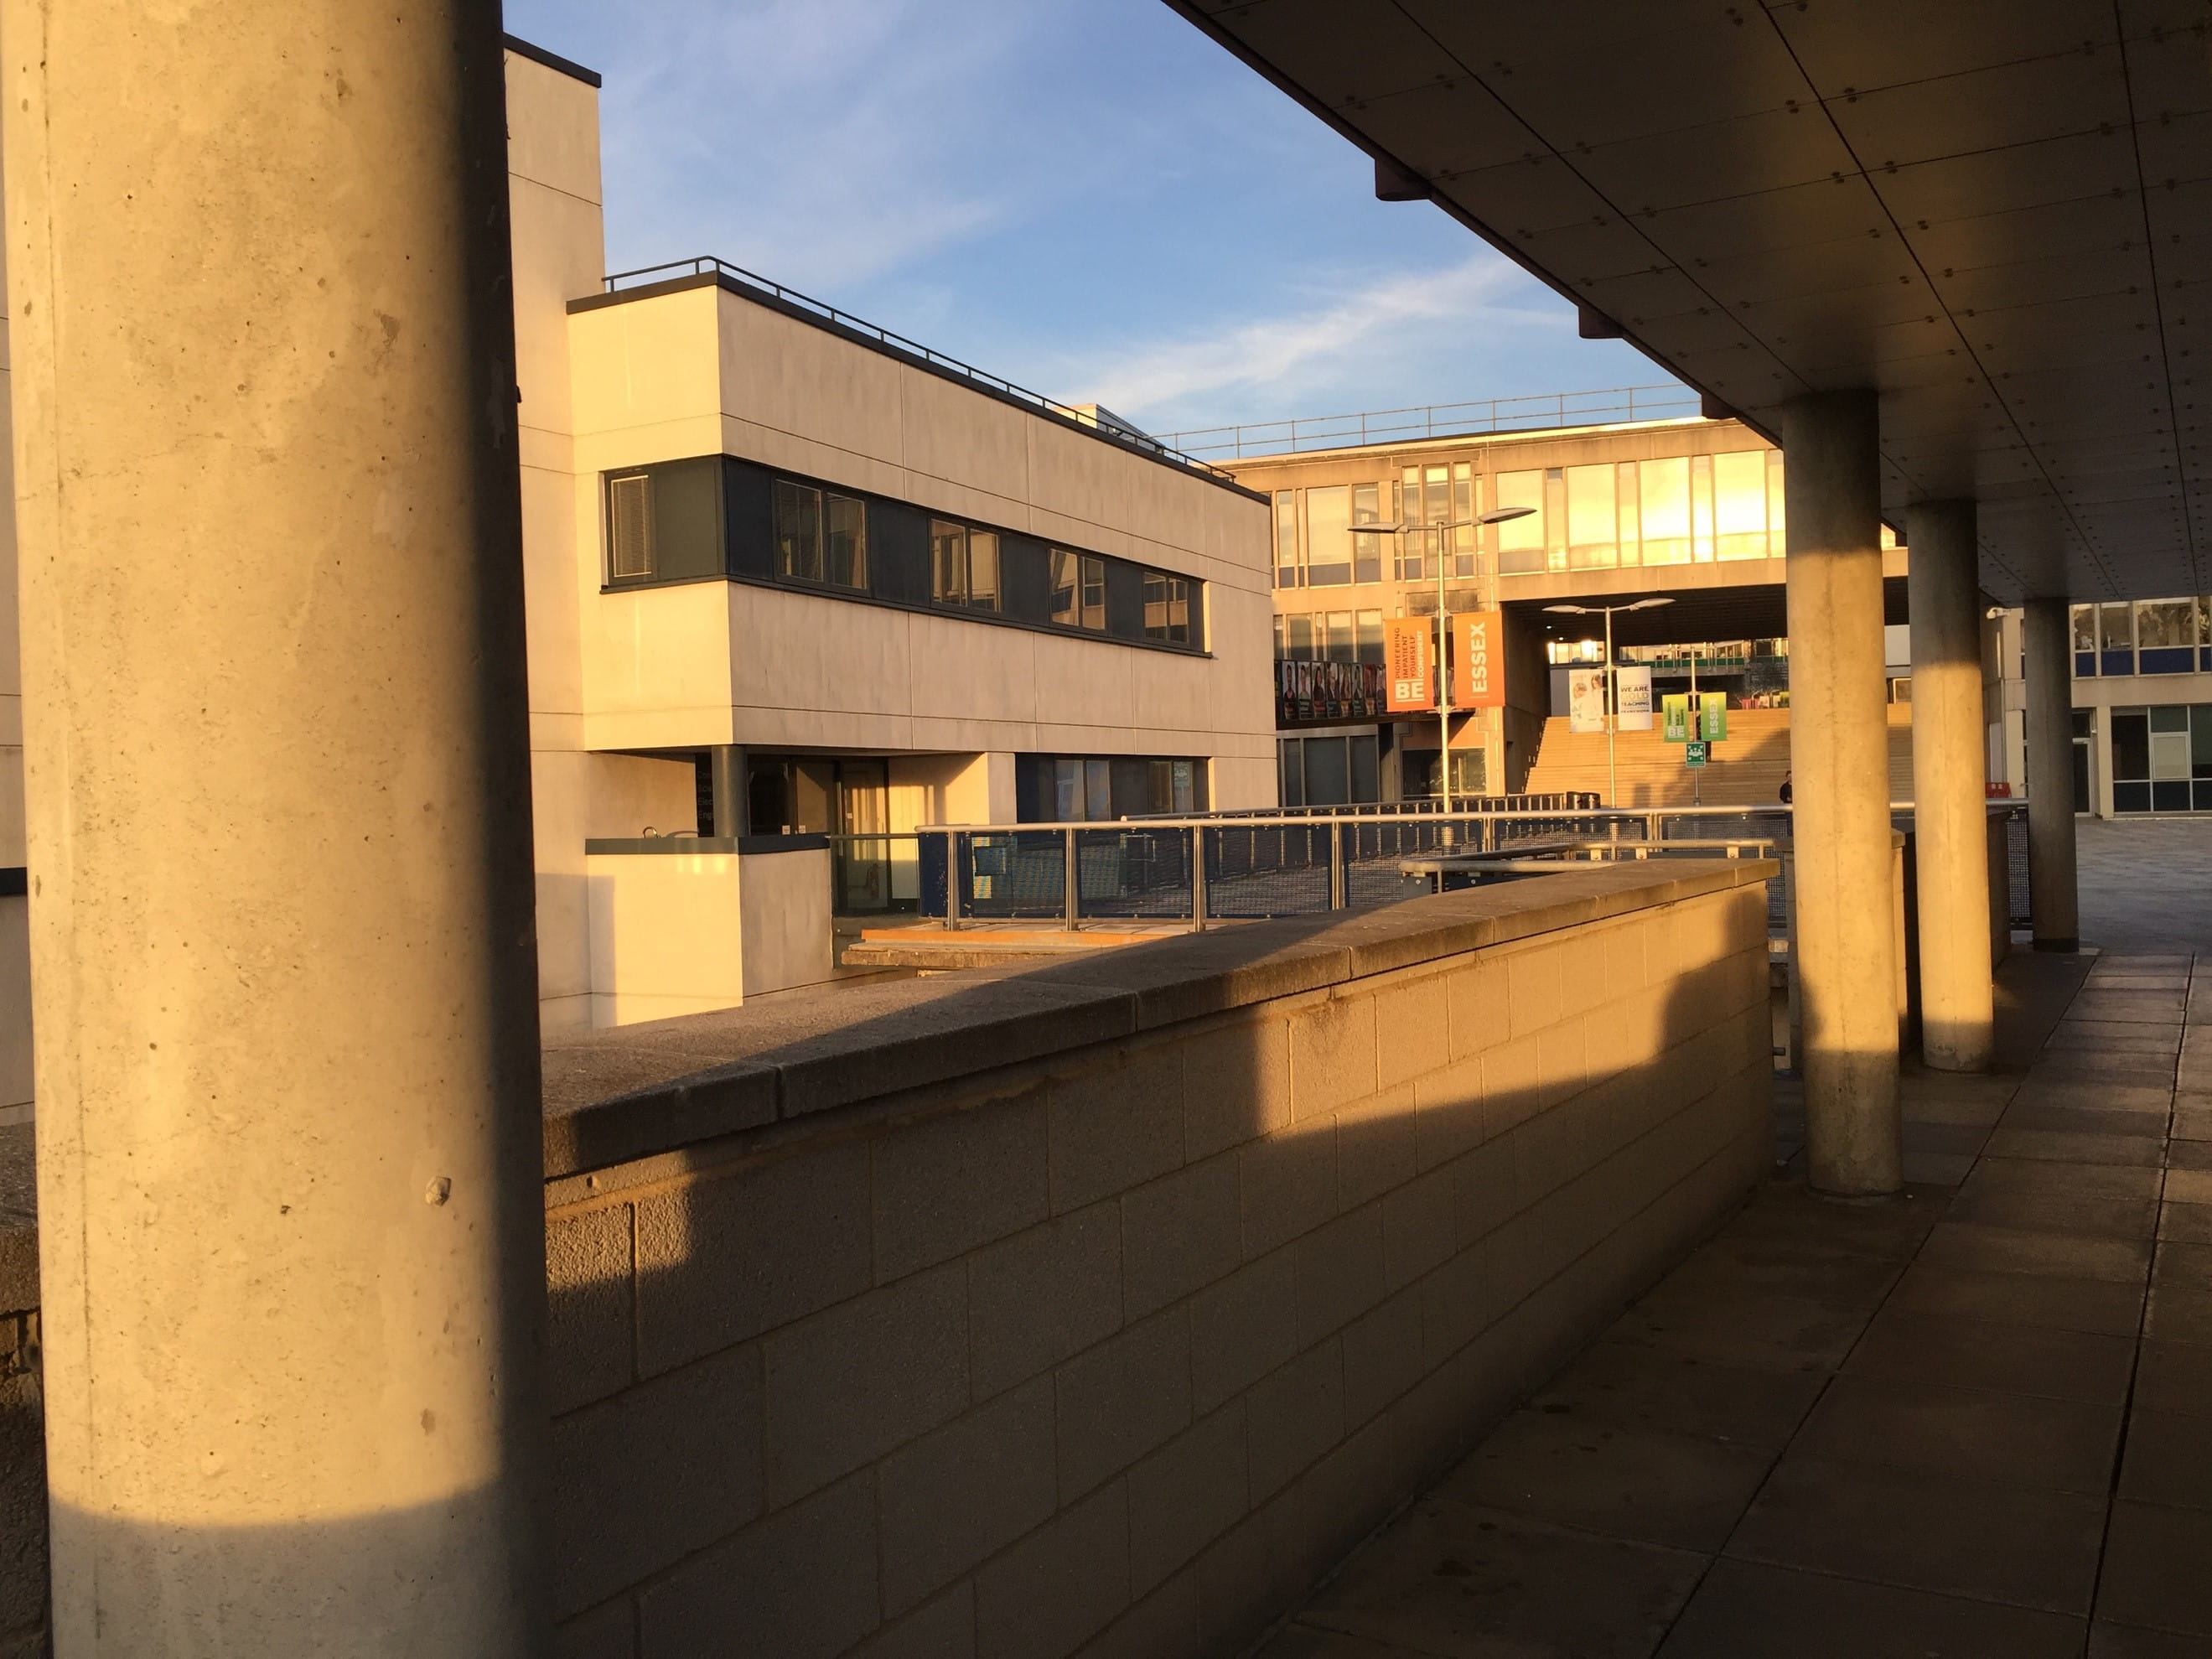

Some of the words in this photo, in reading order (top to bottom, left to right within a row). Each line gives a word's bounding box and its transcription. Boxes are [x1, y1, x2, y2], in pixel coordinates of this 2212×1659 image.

[1470, 621, 1488, 692] ESSEX
[1396, 681, 1425, 699] BE
[1710, 697, 1718, 734] ESSEX
